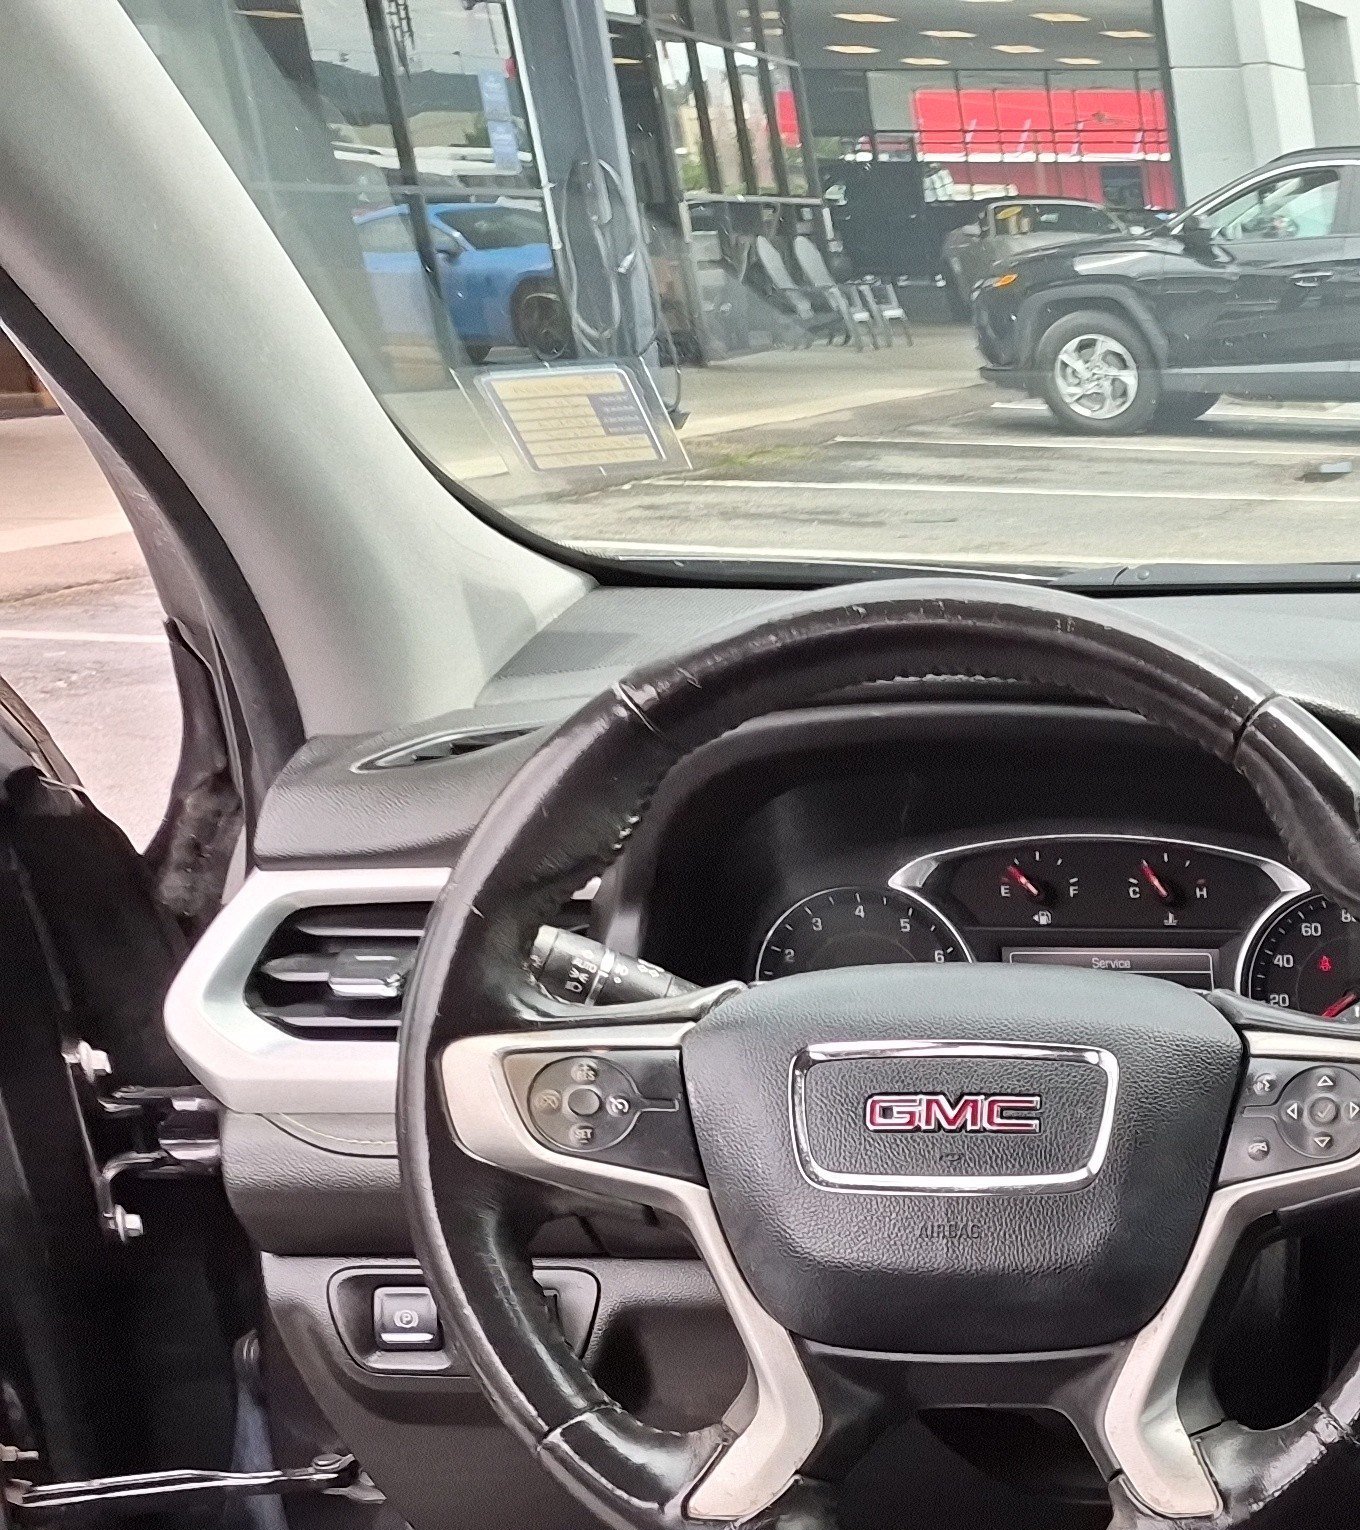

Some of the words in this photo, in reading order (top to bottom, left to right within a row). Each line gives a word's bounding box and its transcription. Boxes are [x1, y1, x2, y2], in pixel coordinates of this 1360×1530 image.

[1001, 885, 1011, 897] E
[1069, 886, 1079, 898] F
[1129, 887, 1140, 899] C
[1196, 887, 1208, 899] H
[855, 905, 865, 918] 4
[812, 917, 823, 931] 3
[900, 918, 910, 932] 5
[1301, 922, 1321, 937] 60
[784, 949, 795, 963] 2
[934, 949, 944, 963] 6
[1091, 957, 1131, 969] Service
[1273, 954, 1294, 968] 40
[1269, 994, 1290, 1007] 20
[866, 1094, 1041, 1133] GMC
[918, 1223, 982, 1239] AIRBAG
